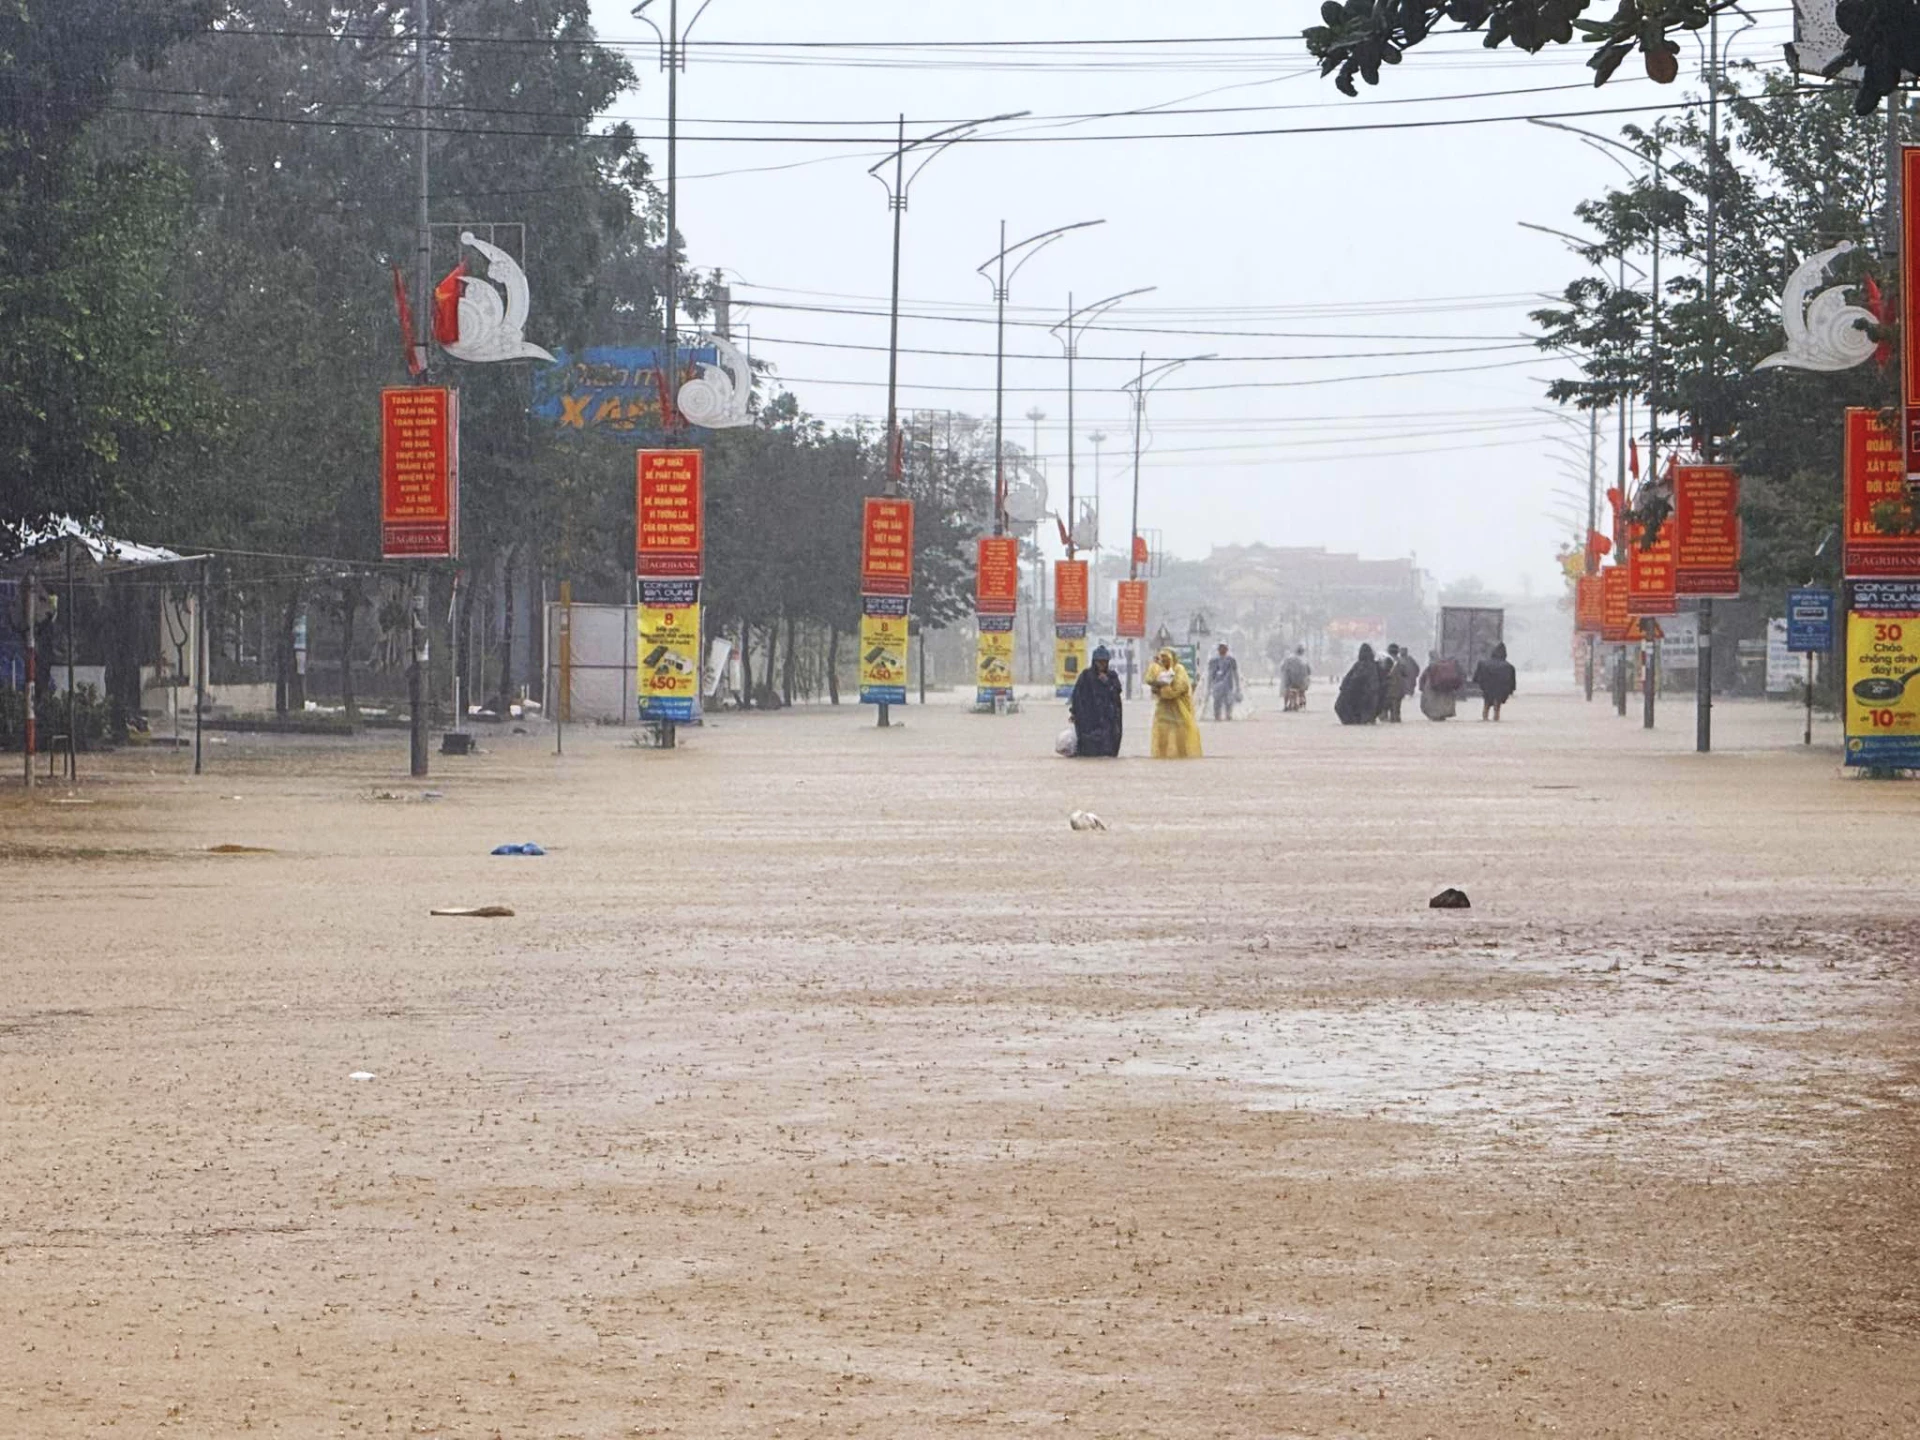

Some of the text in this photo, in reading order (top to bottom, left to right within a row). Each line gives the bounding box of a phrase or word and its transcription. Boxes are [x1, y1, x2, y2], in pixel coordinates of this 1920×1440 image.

[650, 561, 697, 569] AGRIBANK
[664, 613, 674, 627] 8
[1874, 623, 1903, 642] 30
[650, 675, 676, 690] 450
[1869, 709, 1895, 728] 10
